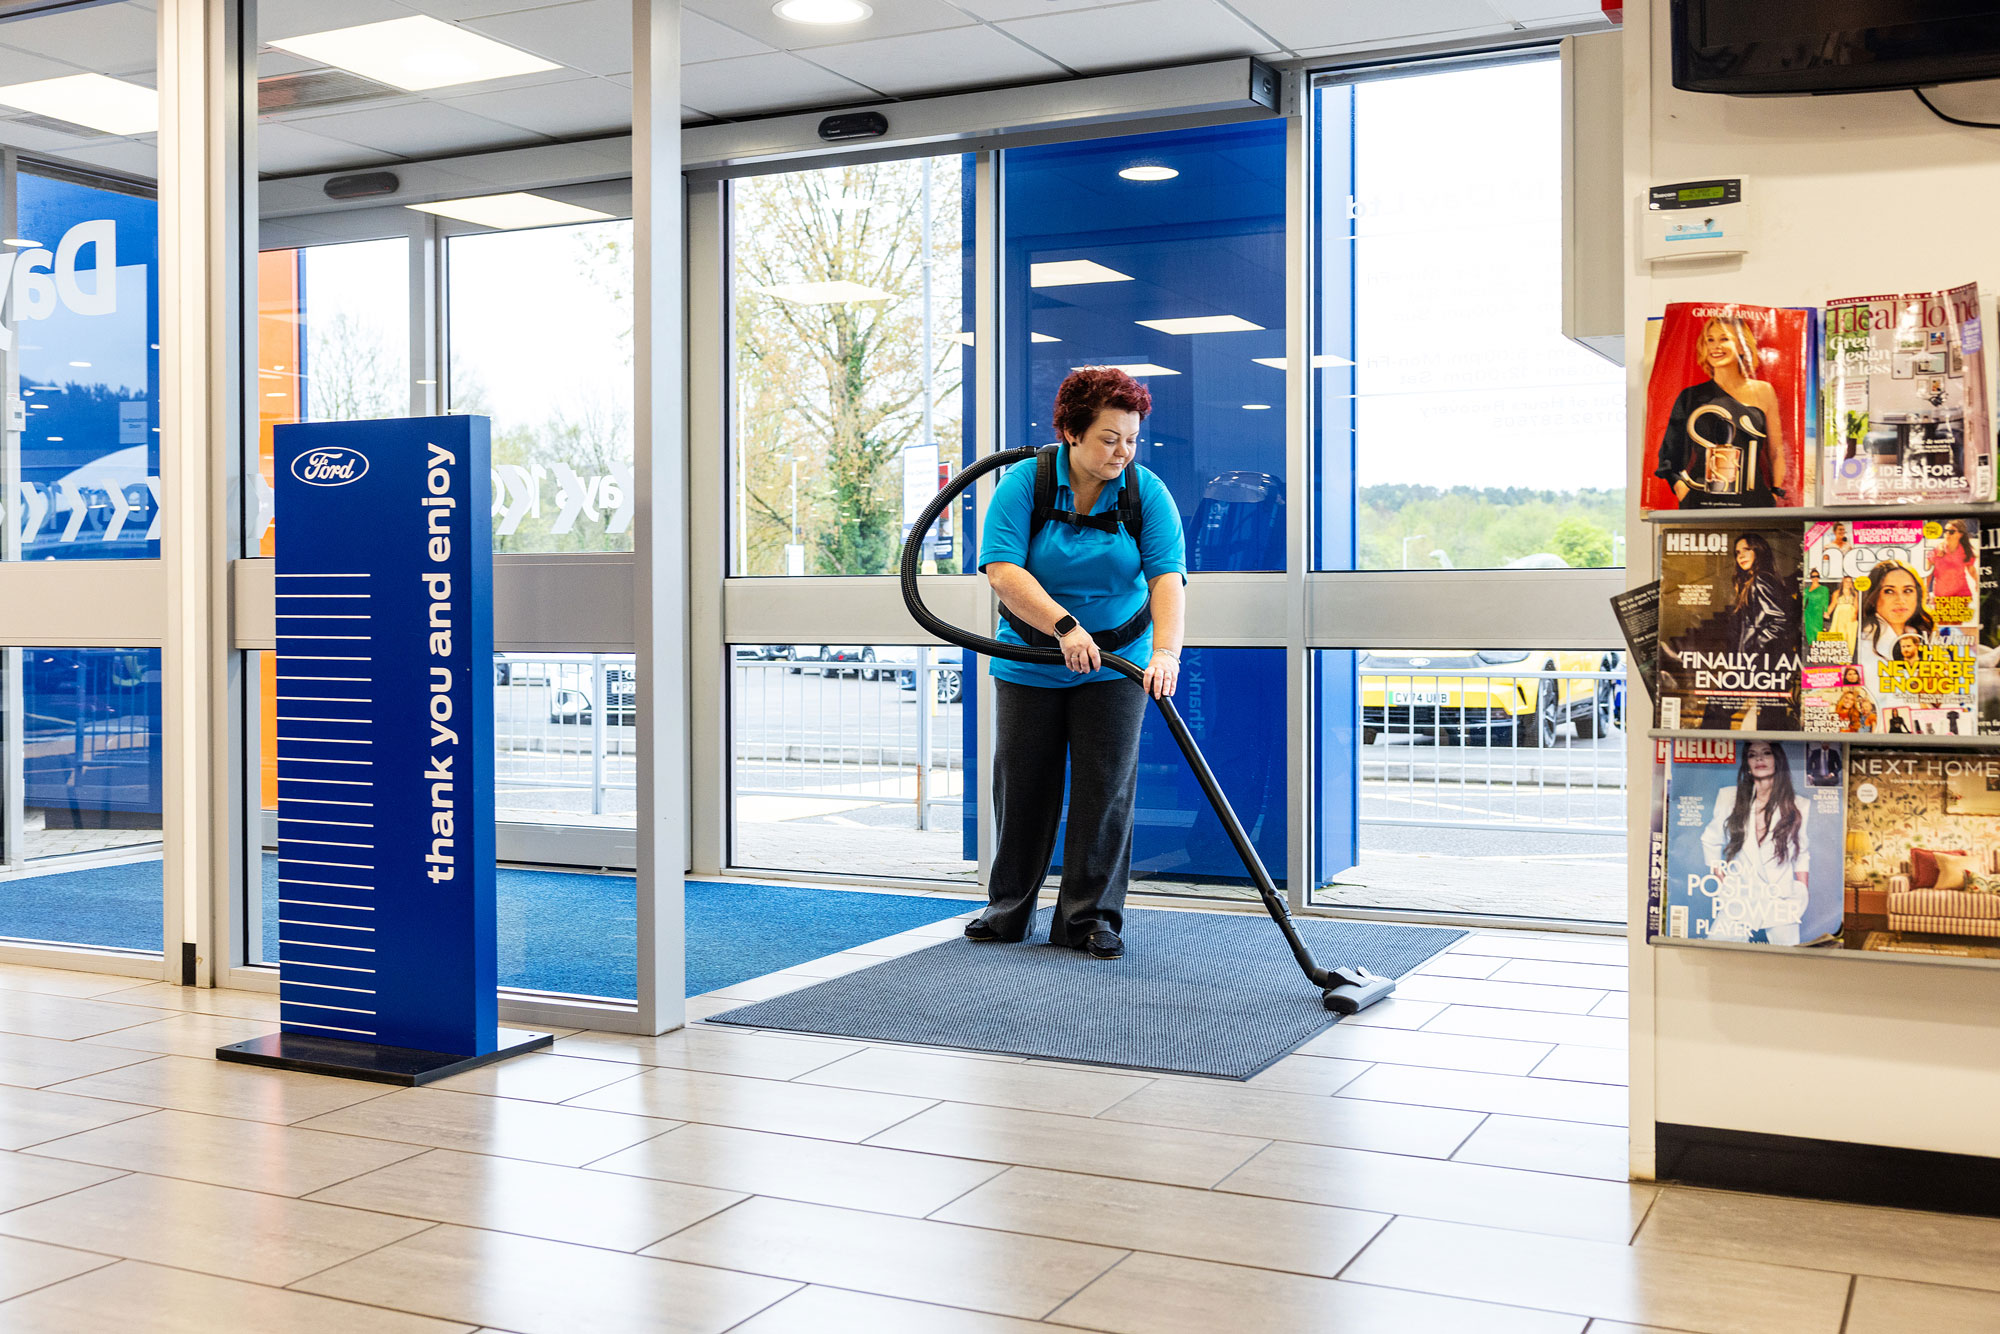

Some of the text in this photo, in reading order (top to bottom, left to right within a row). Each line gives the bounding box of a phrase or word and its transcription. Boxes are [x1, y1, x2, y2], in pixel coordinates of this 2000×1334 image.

[1692, 307, 1732, 318] GIORGIO
[1834, 302, 1897, 334] Ideal
[304, 453, 356, 480] Ford
[1926, 464, 1954, 476] FOR
[1915, 476, 1969, 489] HOMES
[1854, 528, 1890, 536] WEDDING
[1666, 533, 1728, 552] HELLO!
[1806, 530, 1935, 580] heat
[1806, 655, 1853, 664] NEW MUSE
[1820, 648, 1849, 656] MUM'S
[421, 443, 459, 884] thank you and enjoy
[1763, 653, 1769, 670] I
[1878, 661, 1975, 678] NEVER BE
[1695, 670, 1792, 690] ENOUGH'
[1879, 677, 1975, 694] ENOUGH'
[1814, 720, 1850, 728] BIRTHDAY
[1675, 739, 1734, 760] HELLO!
[1852, 759, 2000, 777] NEXT HOME
[1710, 860, 1757, 876] FROM
[1687, 874, 1754, 898] POSH
[1711, 896, 1802, 924] POWER
[1696, 918, 1754, 938] PLAYER
